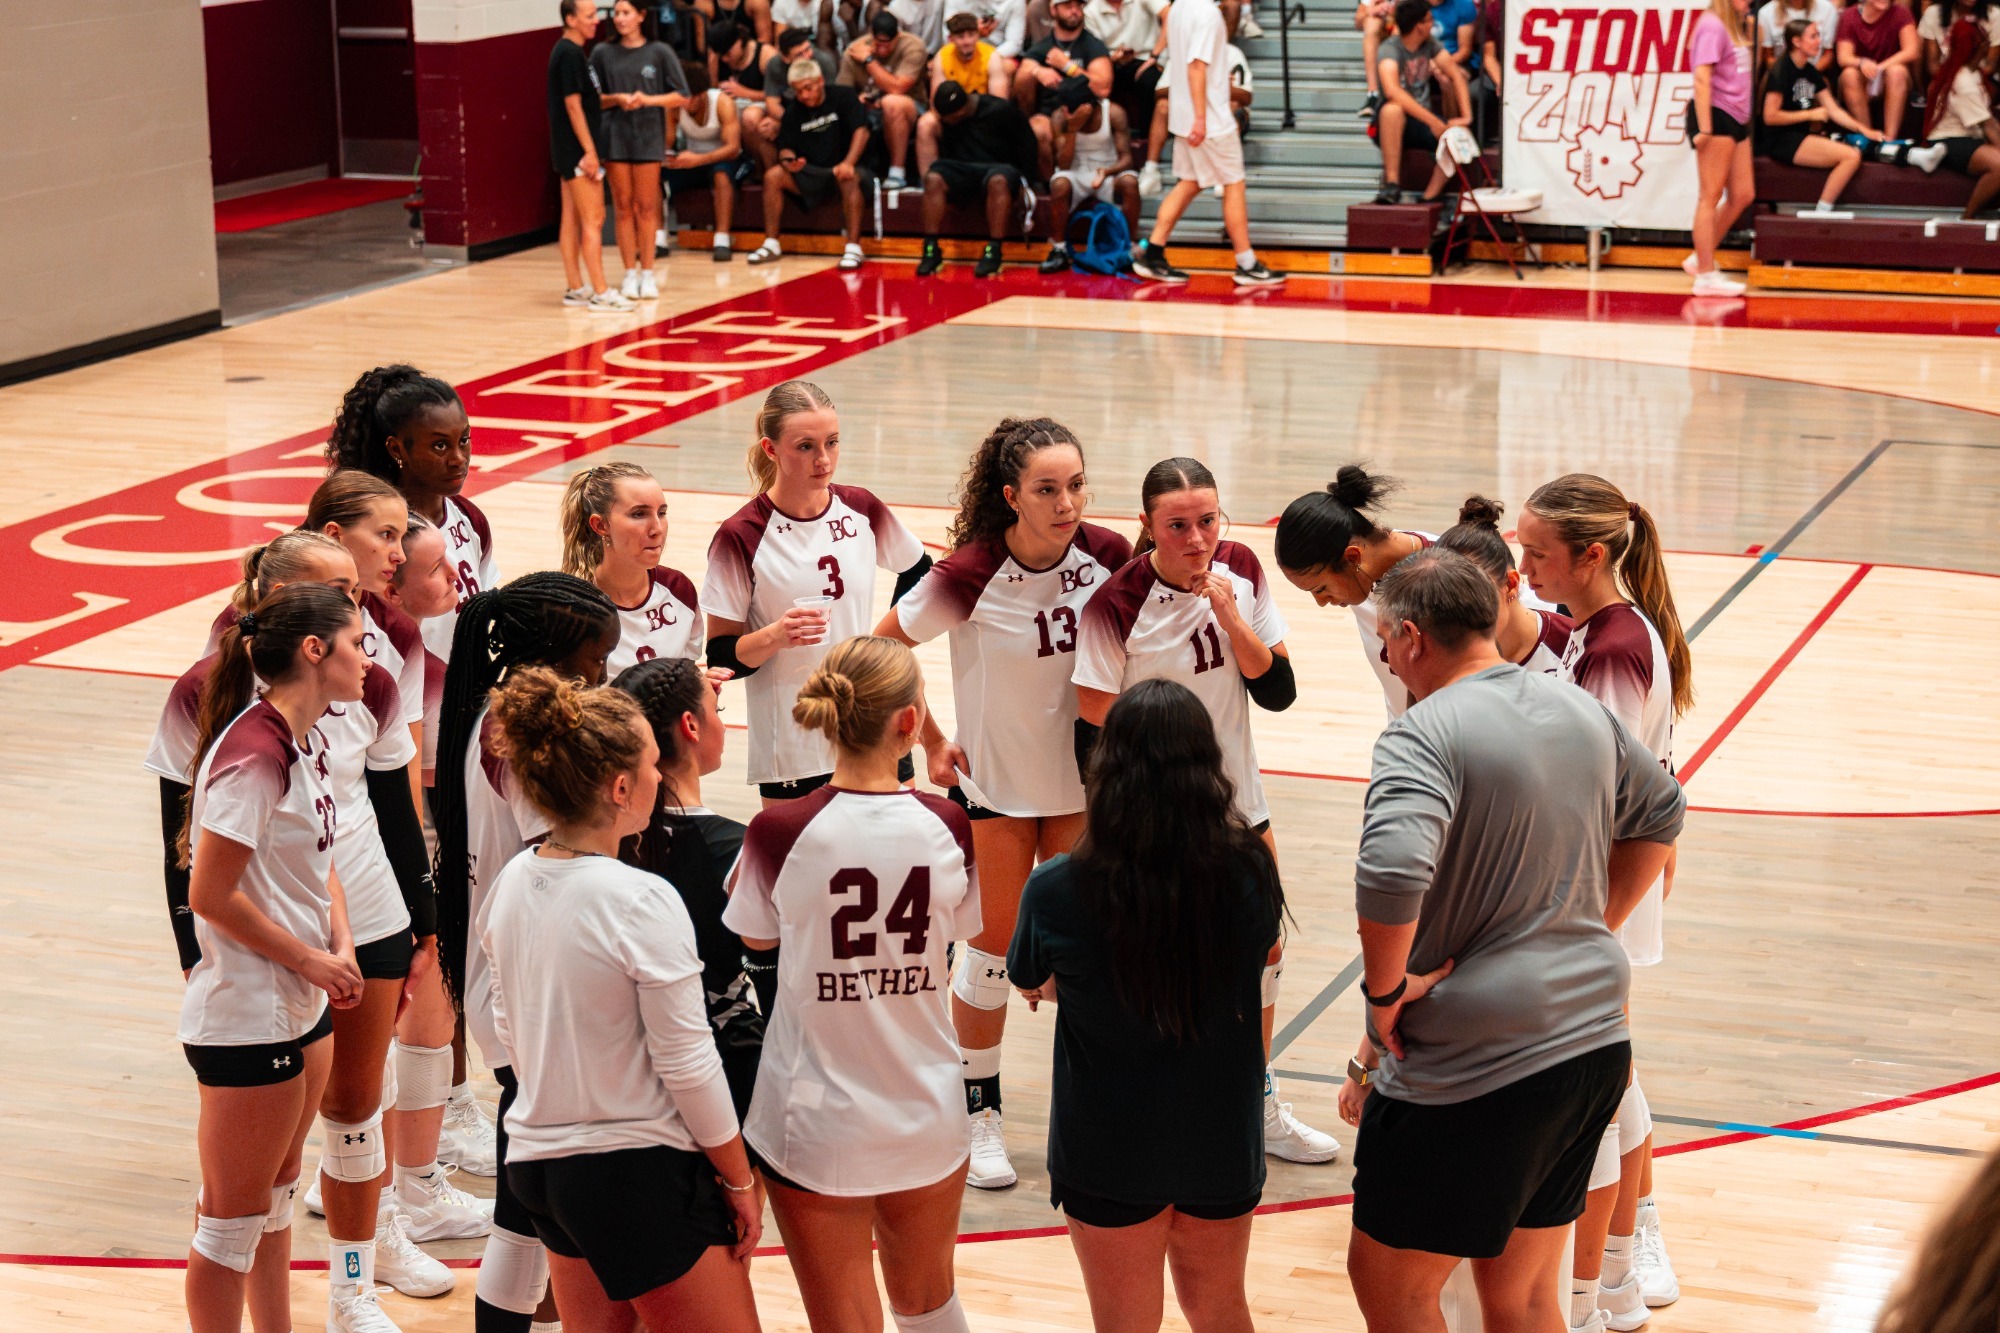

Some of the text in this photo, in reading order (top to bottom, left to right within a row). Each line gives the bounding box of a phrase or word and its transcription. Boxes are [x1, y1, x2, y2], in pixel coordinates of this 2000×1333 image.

[1518, 71, 1694, 145] ZONE
[448, 520, 470, 550] BC
[826, 515, 858, 543] BC
[817, 554, 845, 600] 3
[1058, 563, 1095, 594] BC
[645, 602, 677, 632] BC
[1033, 605, 1077, 659] 13
[1189, 621, 1225, 675] 11
[829, 865, 931, 960] 24
[815, 965, 937, 1002] BETHEL
